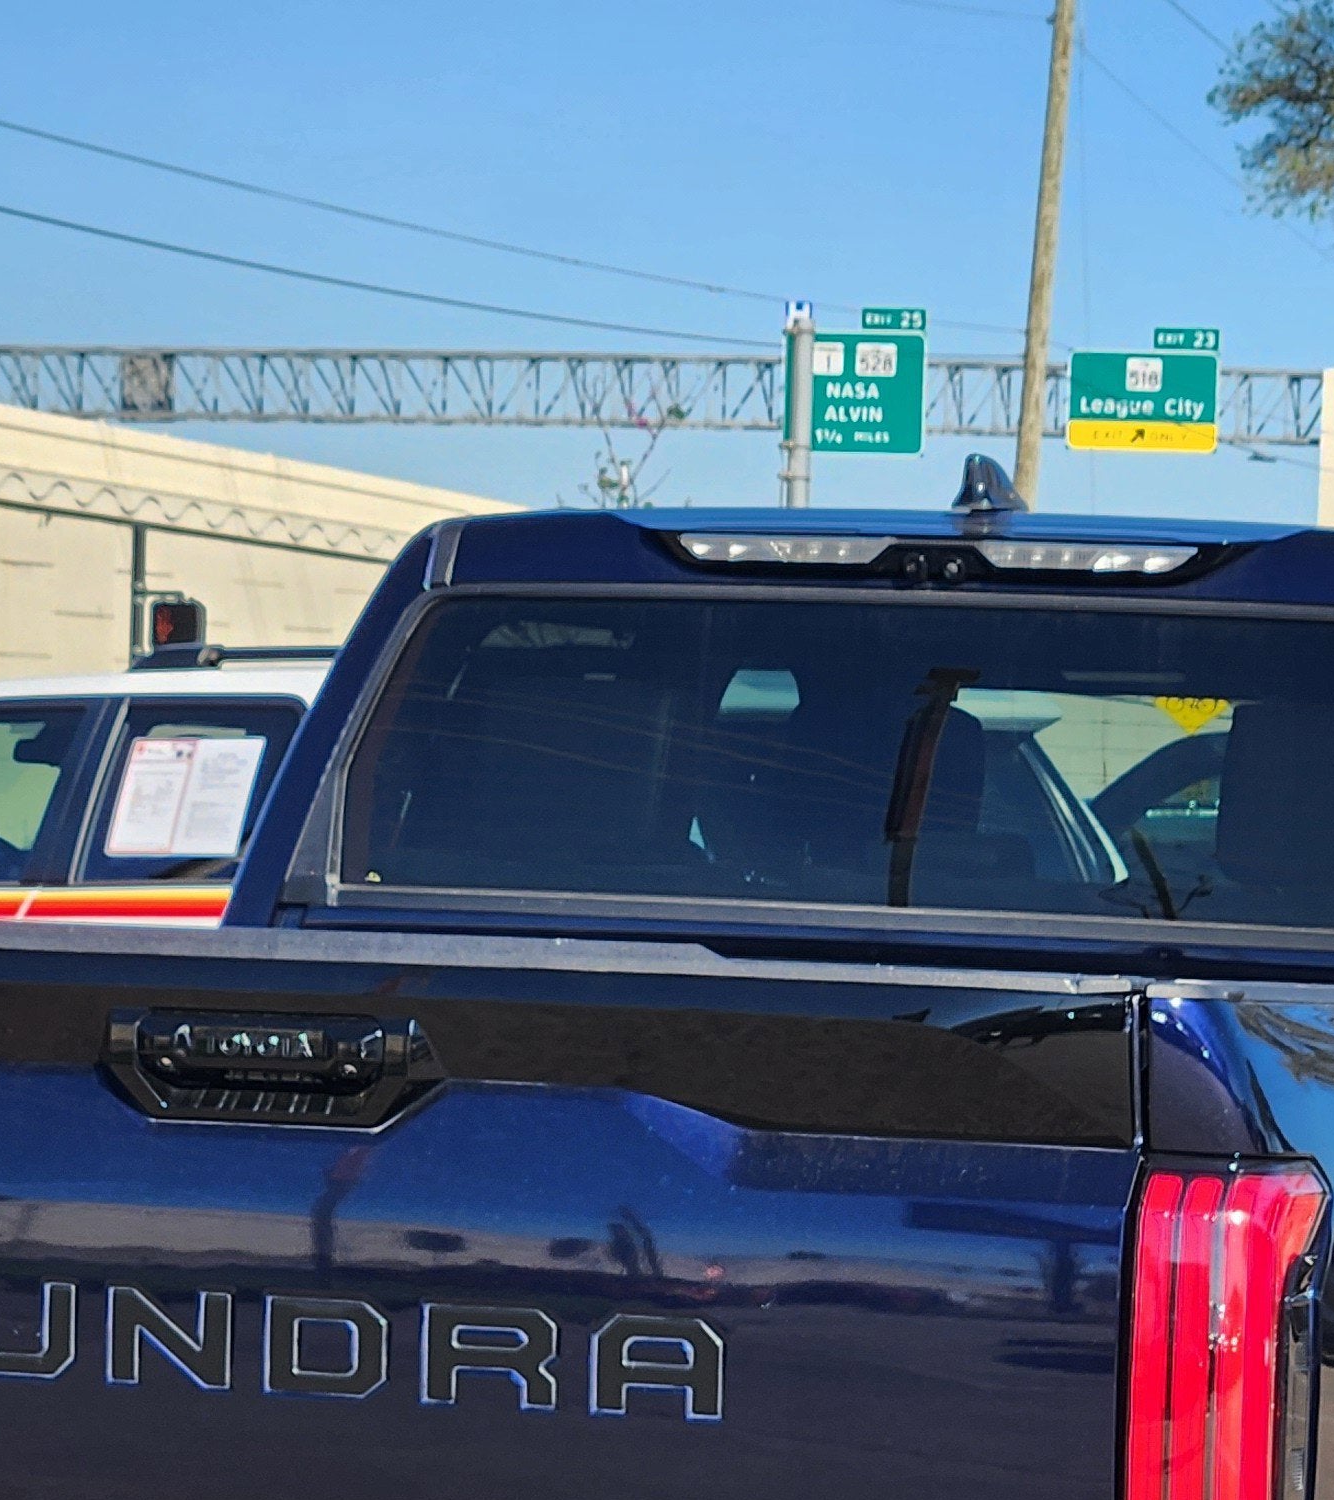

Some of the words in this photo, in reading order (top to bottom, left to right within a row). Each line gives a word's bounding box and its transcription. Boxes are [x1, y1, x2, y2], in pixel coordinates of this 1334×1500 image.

[865, 312, 892, 326] EXIT
[1157, 332, 1185, 346] EXIT
[1193, 330, 1217, 348] 23
[1128, 369, 1159, 387] 518
[825, 381, 880, 400] NASA
[824, 404, 884, 423] ALVIN
[1079, 395, 1155, 419] League
[1164, 397, 1205, 421] City
[853, 430, 890, 444] MILES
